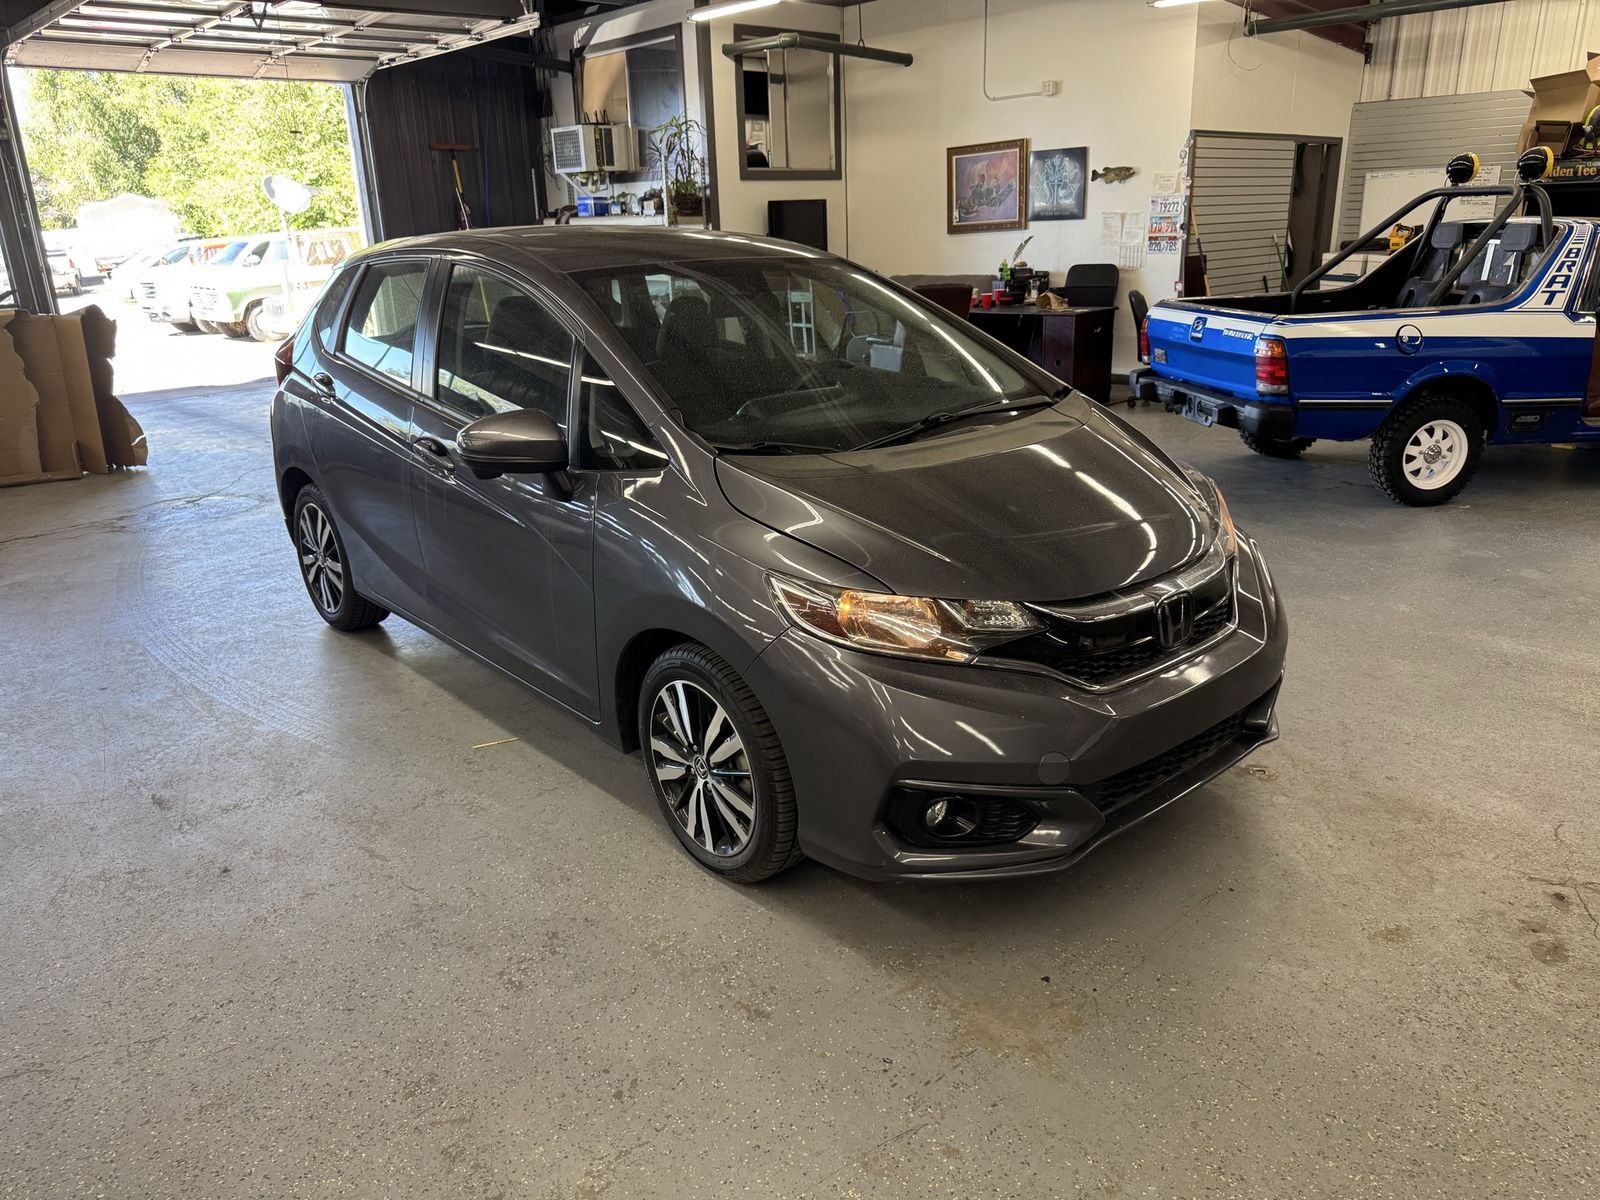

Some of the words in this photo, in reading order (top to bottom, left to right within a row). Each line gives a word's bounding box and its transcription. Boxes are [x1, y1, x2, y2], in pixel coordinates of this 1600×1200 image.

[1549, 165, 1574, 177] den
[1576, 164, 1598, 176] Tee
[1540, 247, 1582, 306] BRAT
